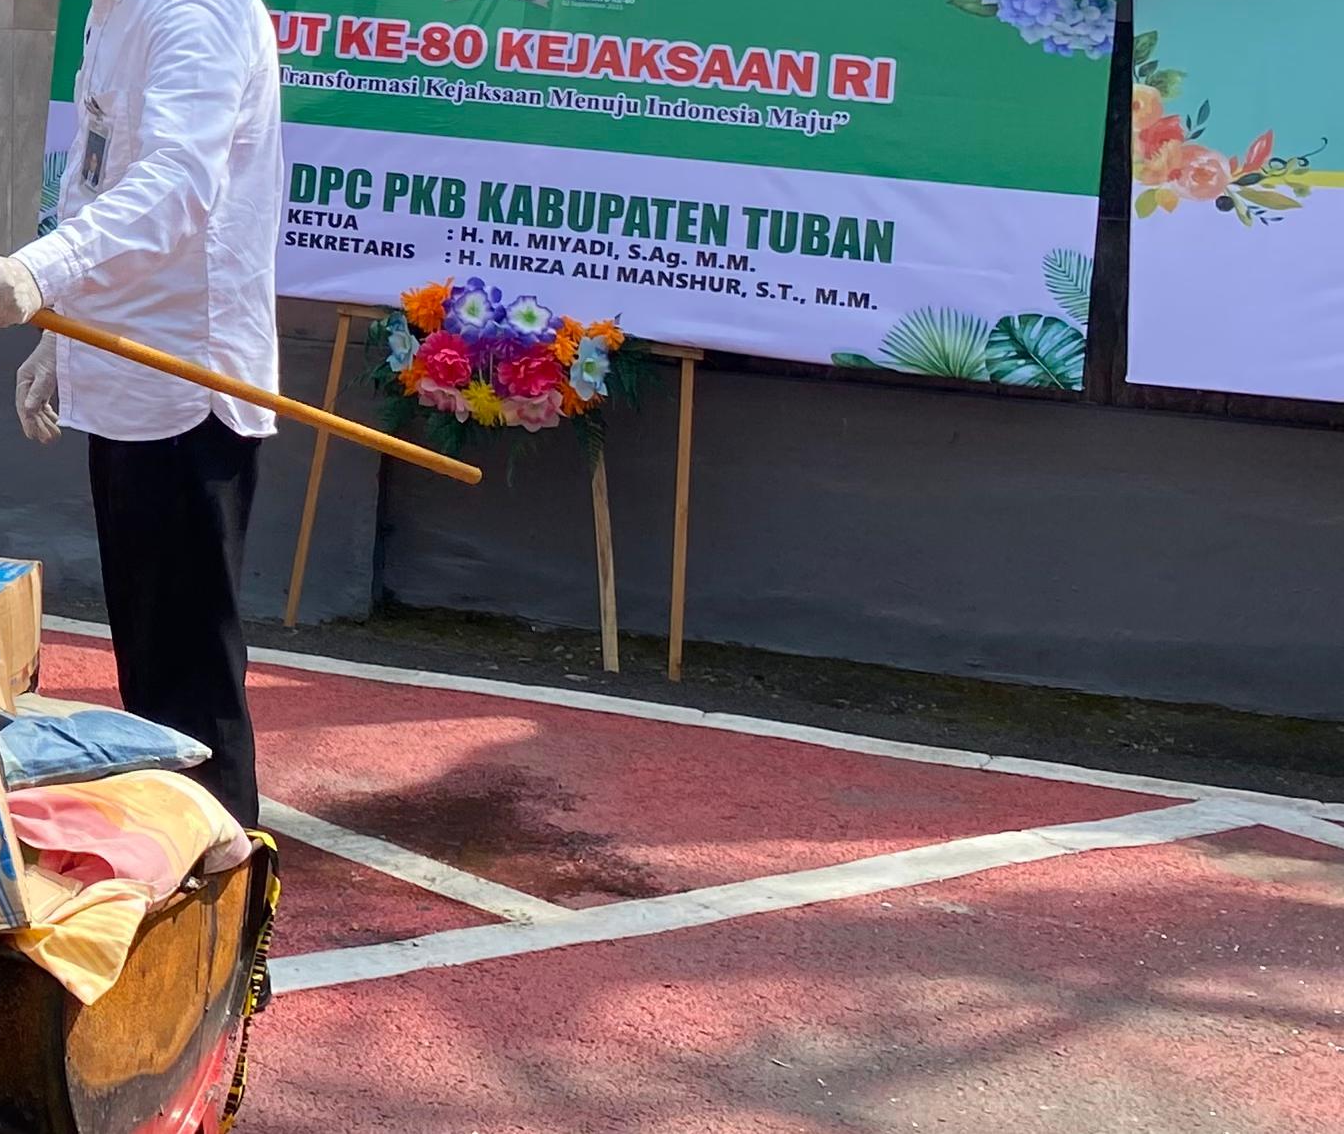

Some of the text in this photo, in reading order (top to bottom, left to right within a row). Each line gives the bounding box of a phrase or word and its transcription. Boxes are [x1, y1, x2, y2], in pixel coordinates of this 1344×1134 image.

[270, 14, 892, 99] UT KE-80 KEJAKSAAN RI
[425, 78, 542, 106] Kejaksaan
[550, 88, 639, 117] Menuju
[647, 96, 760, 125] Indonesia
[287, 208, 359, 230] KETUA
[460, 226, 484, 244] H.
[492, 229, 520, 247] M.
[527, 233, 620, 261] MIYADI,
[627, 243, 688, 269] S.Ag.
[695, 250, 757, 272] M.M.
[288, 162, 895, 264] DPC PKB KABUPATEN TUBAN
[284, 230, 416, 259] SEKRETARIS
[458, 249, 482, 267] H.
[489, 252, 566, 276] MIRZA
[571, 262, 609, 280] ALI
[616, 266, 748, 299] MANSHUR,
[815, 287, 879, 311] M.M.
